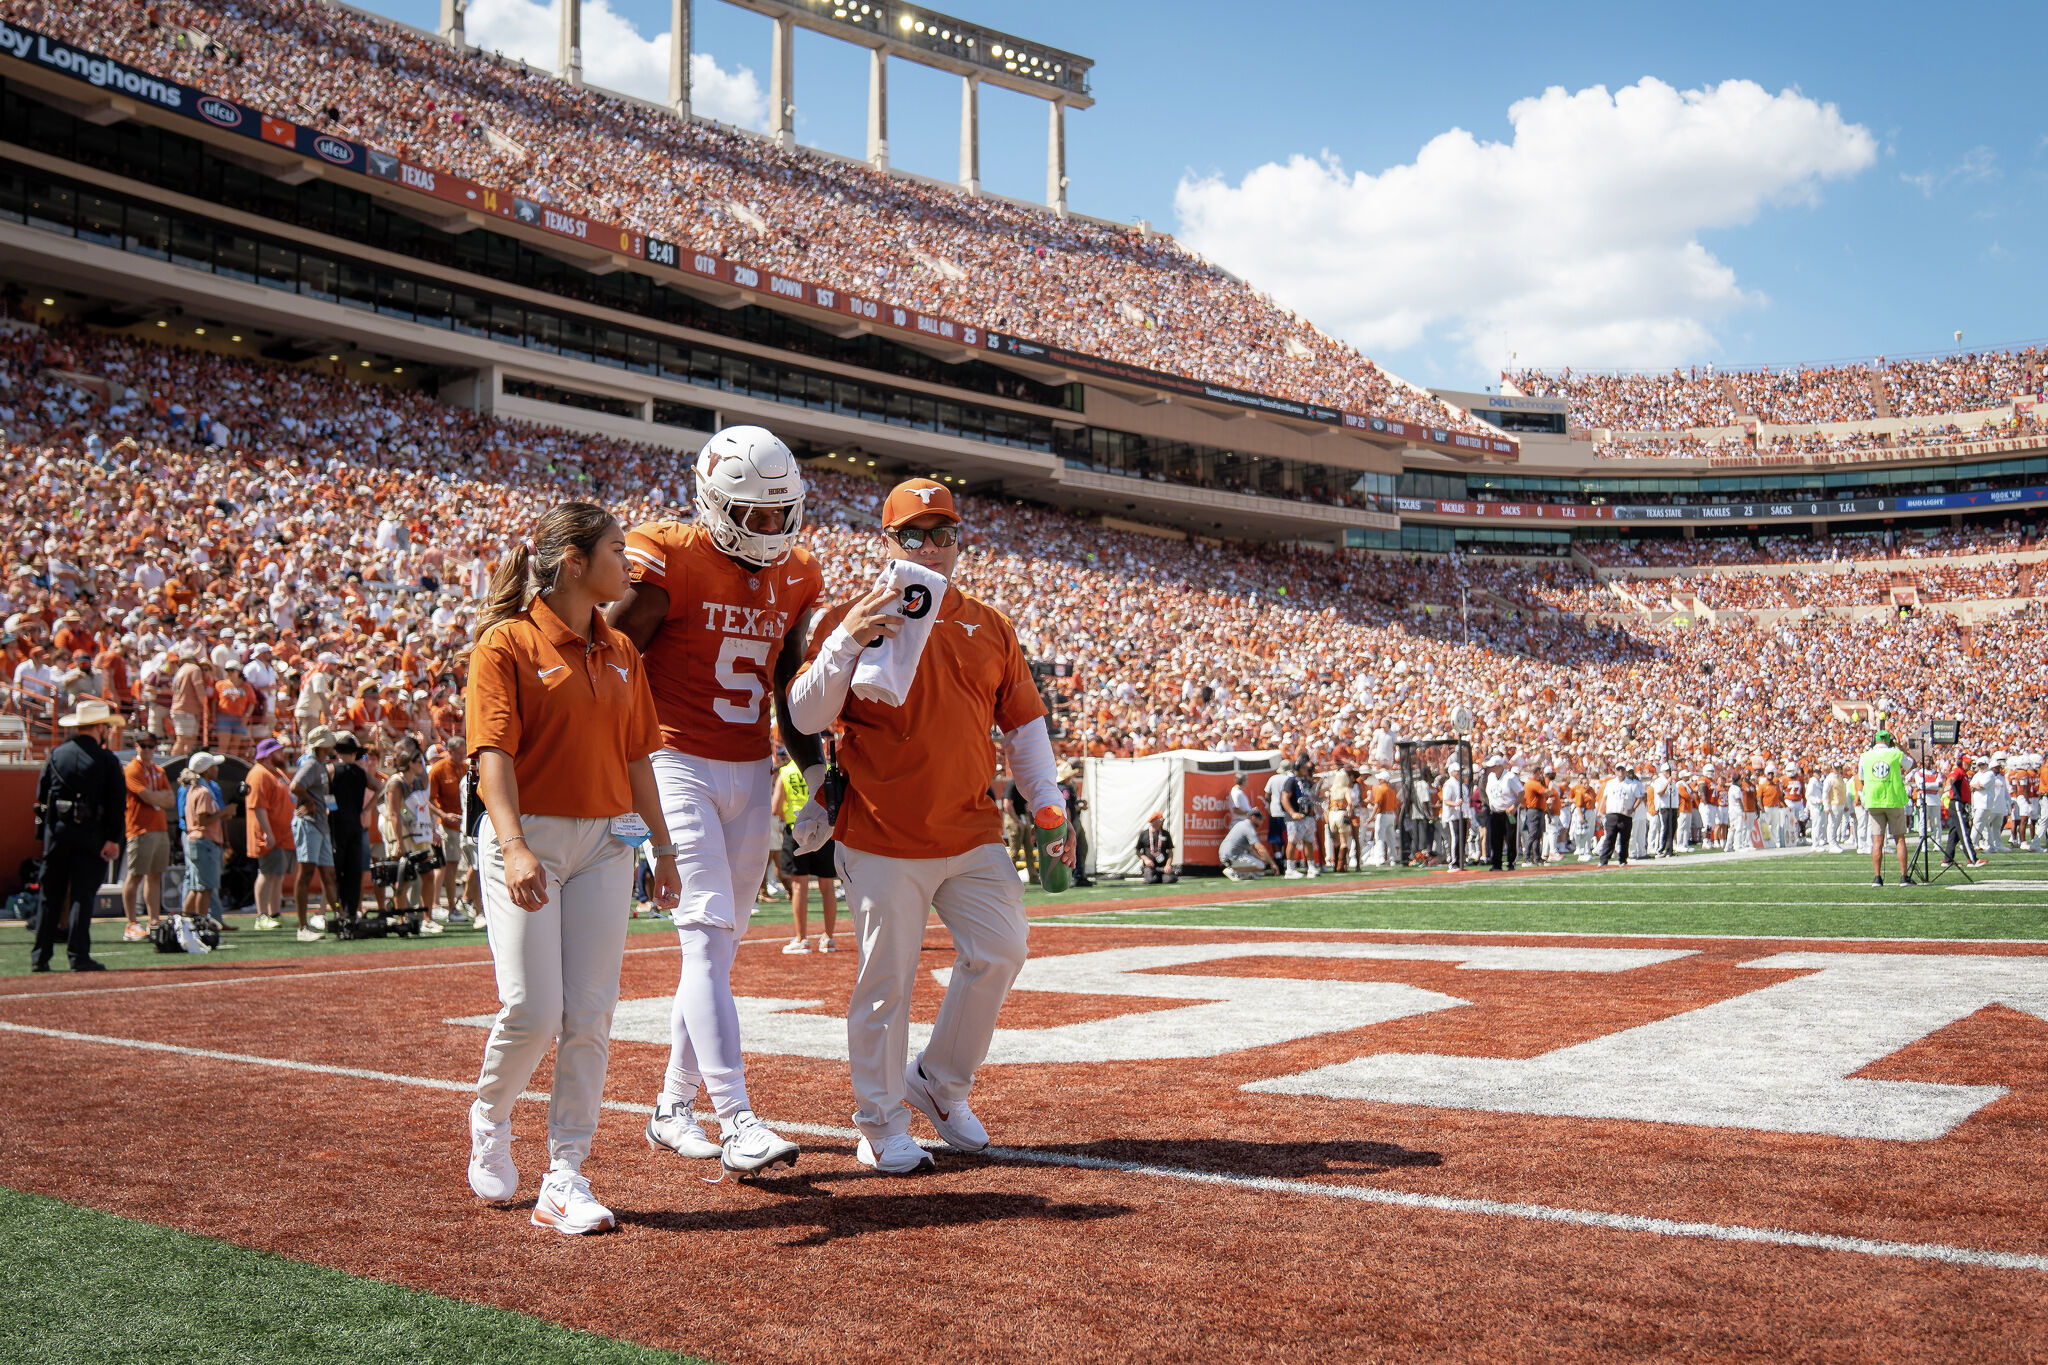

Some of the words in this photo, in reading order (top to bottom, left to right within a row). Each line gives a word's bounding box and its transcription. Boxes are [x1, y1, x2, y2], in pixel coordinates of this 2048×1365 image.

[0, 19, 34, 58] by
[38, 36, 182, 107] Longhorns
[204, 100, 235, 123] ufcu
[320, 140, 349, 160] ufcu
[401, 166, 435, 192] TEXAS
[483, 190, 497, 212] 14
[544, 210, 576, 235] TEXAS
[576, 220, 588, 238] ST
[620, 232, 629, 250] 0
[649, 241, 674, 264] 9:41
[694, 253, 716, 276] QTR
[734, 266, 758, 288] 2ND
[771, 276, 802, 299] DOWN
[816, 288, 835, 308] 1ST
[850, 297, 863, 315] TO
[863, 299, 877, 318] GO
[893, 309, 906, 327] 10
[917, 315, 939, 334] BALL
[939, 321, 954, 338] ON
[964, 327, 977, 345] 25
[1489, 397, 1514, 408] DELL
[1515, 399, 1565, 411] Technologies
[1345, 414, 1357, 427] TOP
[1357, 416, 1366, 428] 25
[1422, 429, 1427, 440] 0
[1455, 434, 1469, 447] UTAH
[1469, 437, 1482, 449] TECH
[1761, 456, 1804, 465] CHAMPIONS
[768, 487, 788, 495] HORNS
[1990, 492, 2009, 500] HOOK
[1398, 499, 1421, 511] EXAS
[1441, 503, 1465, 513] TACKLES
[1476, 504, 1485, 515] 27
[1811, 504, 1817, 515] 0
[1878, 500, 1884, 511] 0
[1922, 498, 1944, 506] LIGHT
[1501, 505, 1521, 516] SACKS
[1537, 506, 1542, 517] 0
[1596, 508, 1602, 518] 4
[1646, 508, 1664, 518] TEXAS
[1664, 508, 1682, 518] STATE
[1702, 507, 1731, 518] TACKLES
[1770, 505, 1792, 516] SACKS
[703, 601, 788, 638] TEXAS
[713, 636, 772, 724] 5
